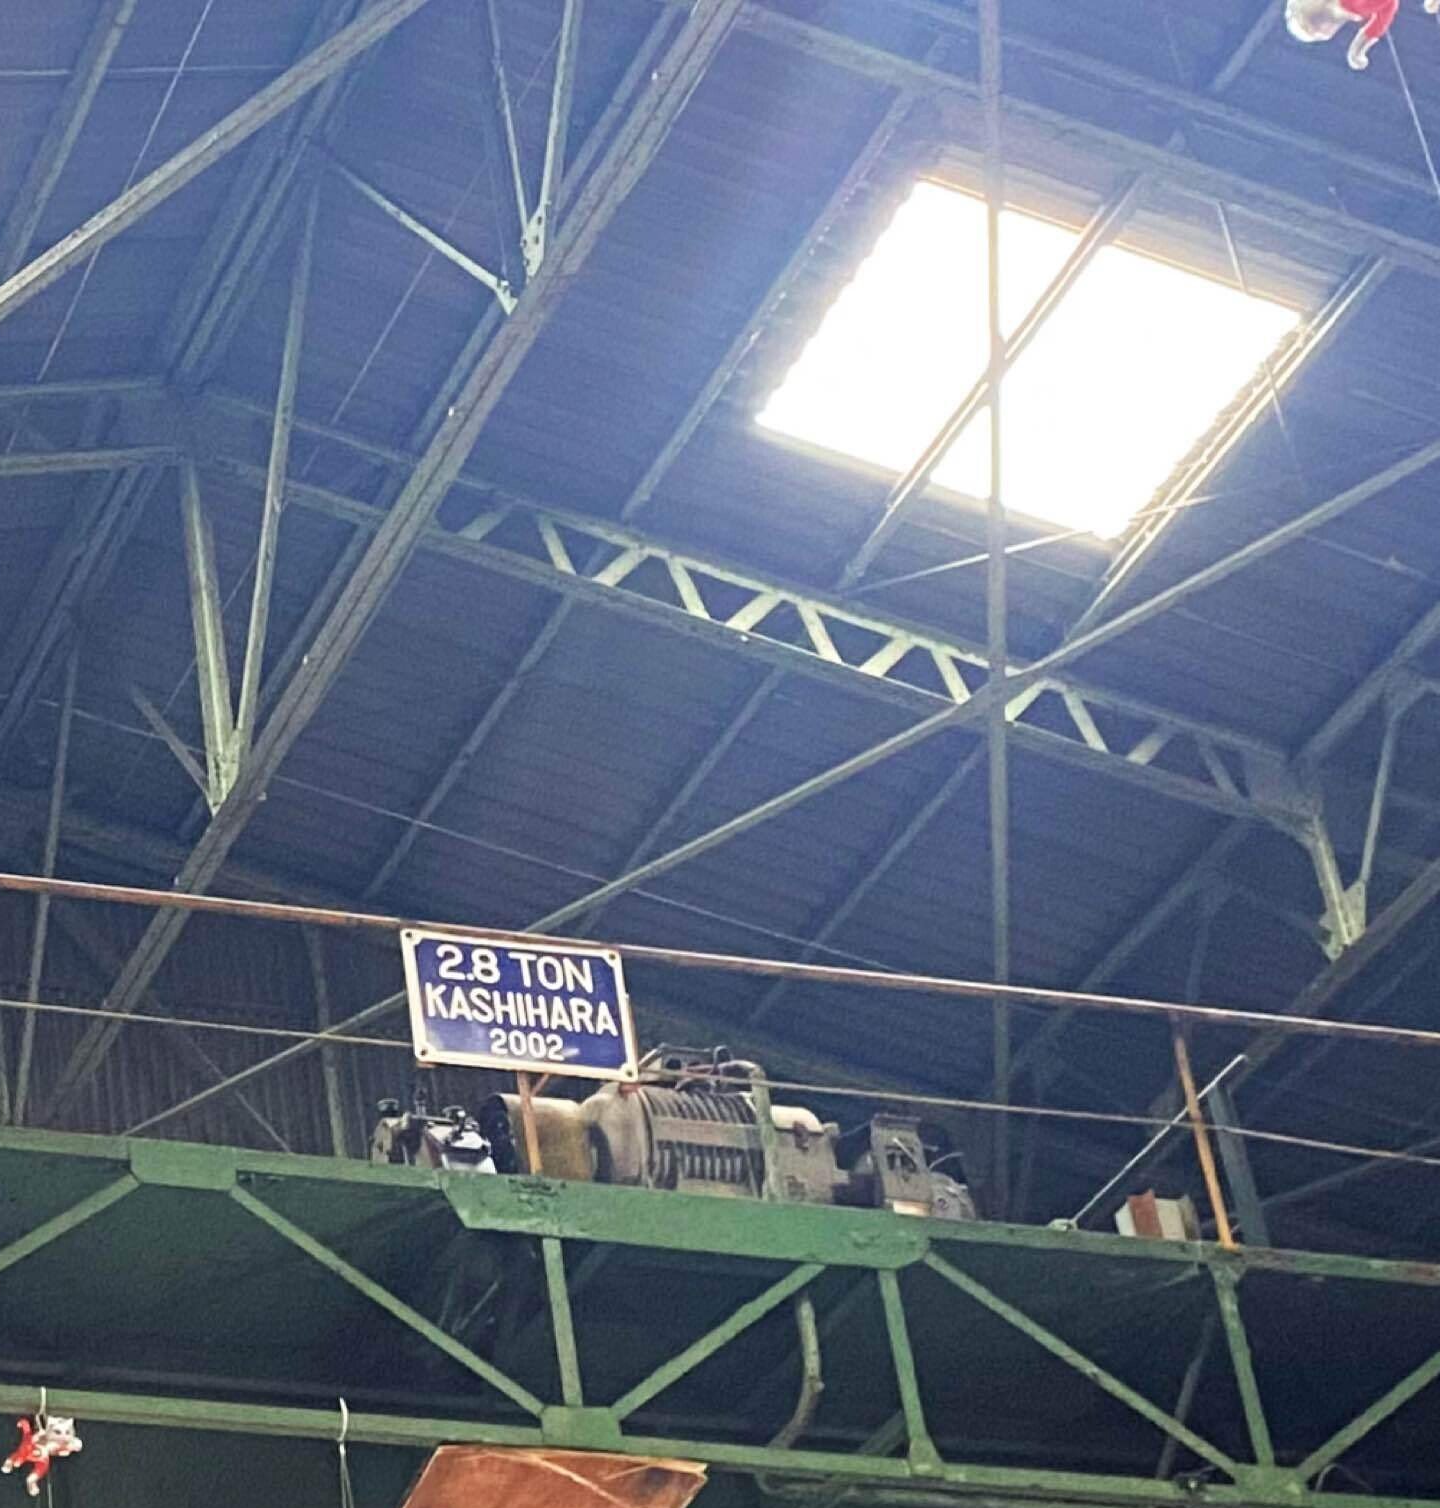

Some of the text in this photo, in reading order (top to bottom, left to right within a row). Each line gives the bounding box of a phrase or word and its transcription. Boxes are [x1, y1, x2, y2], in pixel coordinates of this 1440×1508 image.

[436, 945, 593, 993] 2.8 TON
[425, 983, 618, 1036] KASHIHARA
